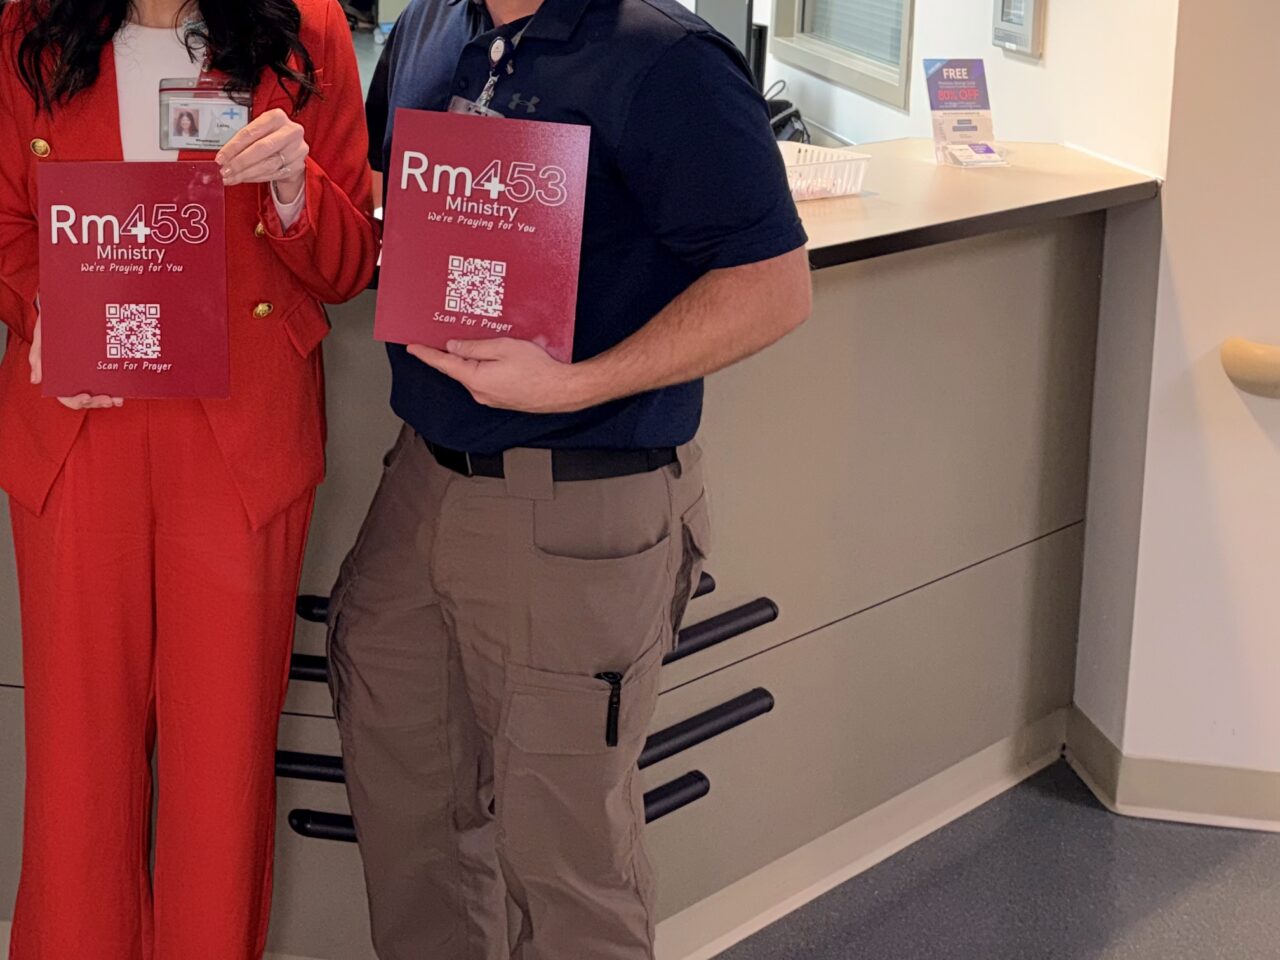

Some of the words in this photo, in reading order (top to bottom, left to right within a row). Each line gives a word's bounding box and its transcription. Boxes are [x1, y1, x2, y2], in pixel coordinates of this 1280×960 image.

[942, 68, 969, 79] FREE
[400, 150, 567, 206] Rm453
[445, 196, 518, 221] Ministry
[50, 203, 210, 245] Rm453
[427, 212, 453, 223] We're
[457, 215, 494, 230] Praying
[498, 220, 513, 230] for
[518, 222, 536, 233] You
[96, 245, 165, 263] Ministry
[81, 263, 105, 272] We're
[109, 263, 144, 274] Praying
[148, 263, 162, 272] for
[166, 263, 183, 272] You
[433, 312, 456, 323] Scan
[460, 316, 476, 326] For
[480, 318, 513, 332] Prayer
[96, 361, 118, 370] Scan
[123, 361, 138, 370] For
[142, 361, 172, 373] Prayer
